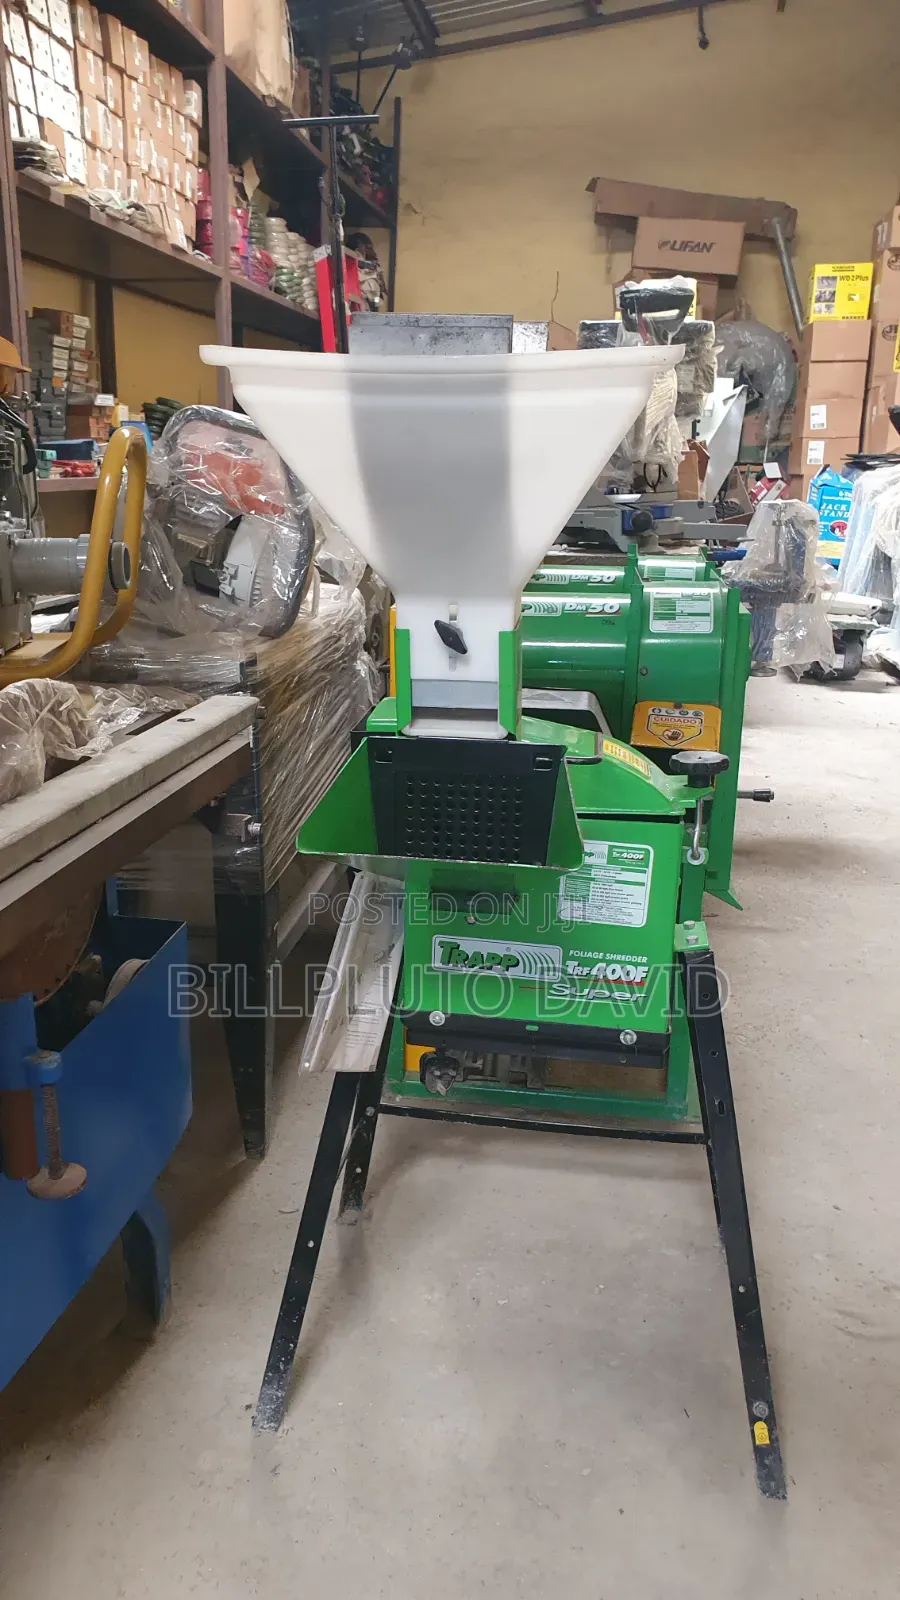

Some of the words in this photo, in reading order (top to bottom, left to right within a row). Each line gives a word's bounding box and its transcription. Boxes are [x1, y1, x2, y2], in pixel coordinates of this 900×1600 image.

[670, 240, 716, 253] LIFAN
[821, 503, 848, 511] JACK
[653, 716, 697, 724] CUIDADO
[438, 941, 520, 971] TRAPP
[569, 949, 604, 960] FOLIAGE
[605, 952, 648, 963] SHREDDER
[549, 983, 647, 1003] Super
